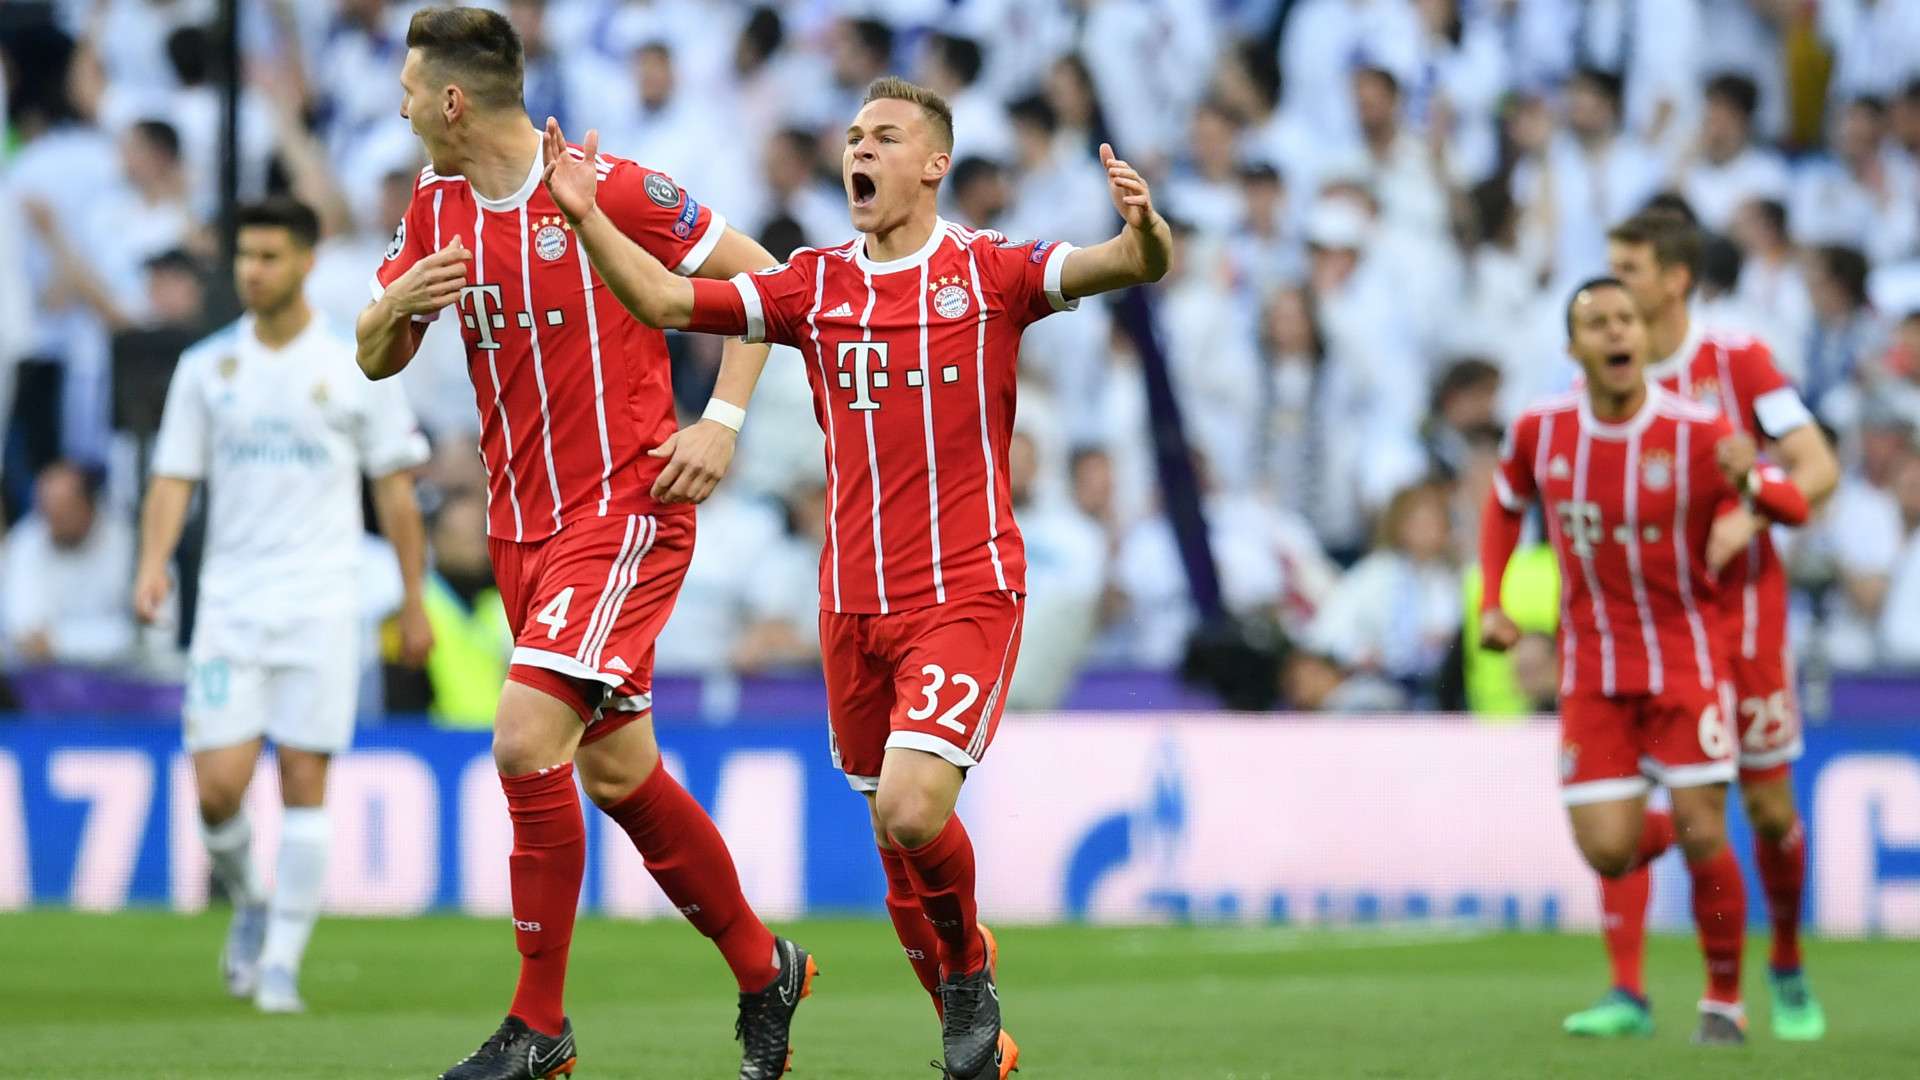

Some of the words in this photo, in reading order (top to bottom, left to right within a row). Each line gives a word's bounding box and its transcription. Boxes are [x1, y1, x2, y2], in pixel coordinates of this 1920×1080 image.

[536, 586, 575, 640] 4
[907, 663, 979, 735] 32
[1741, 690, 1796, 749] 25
[1698, 703, 1733, 759] 6
